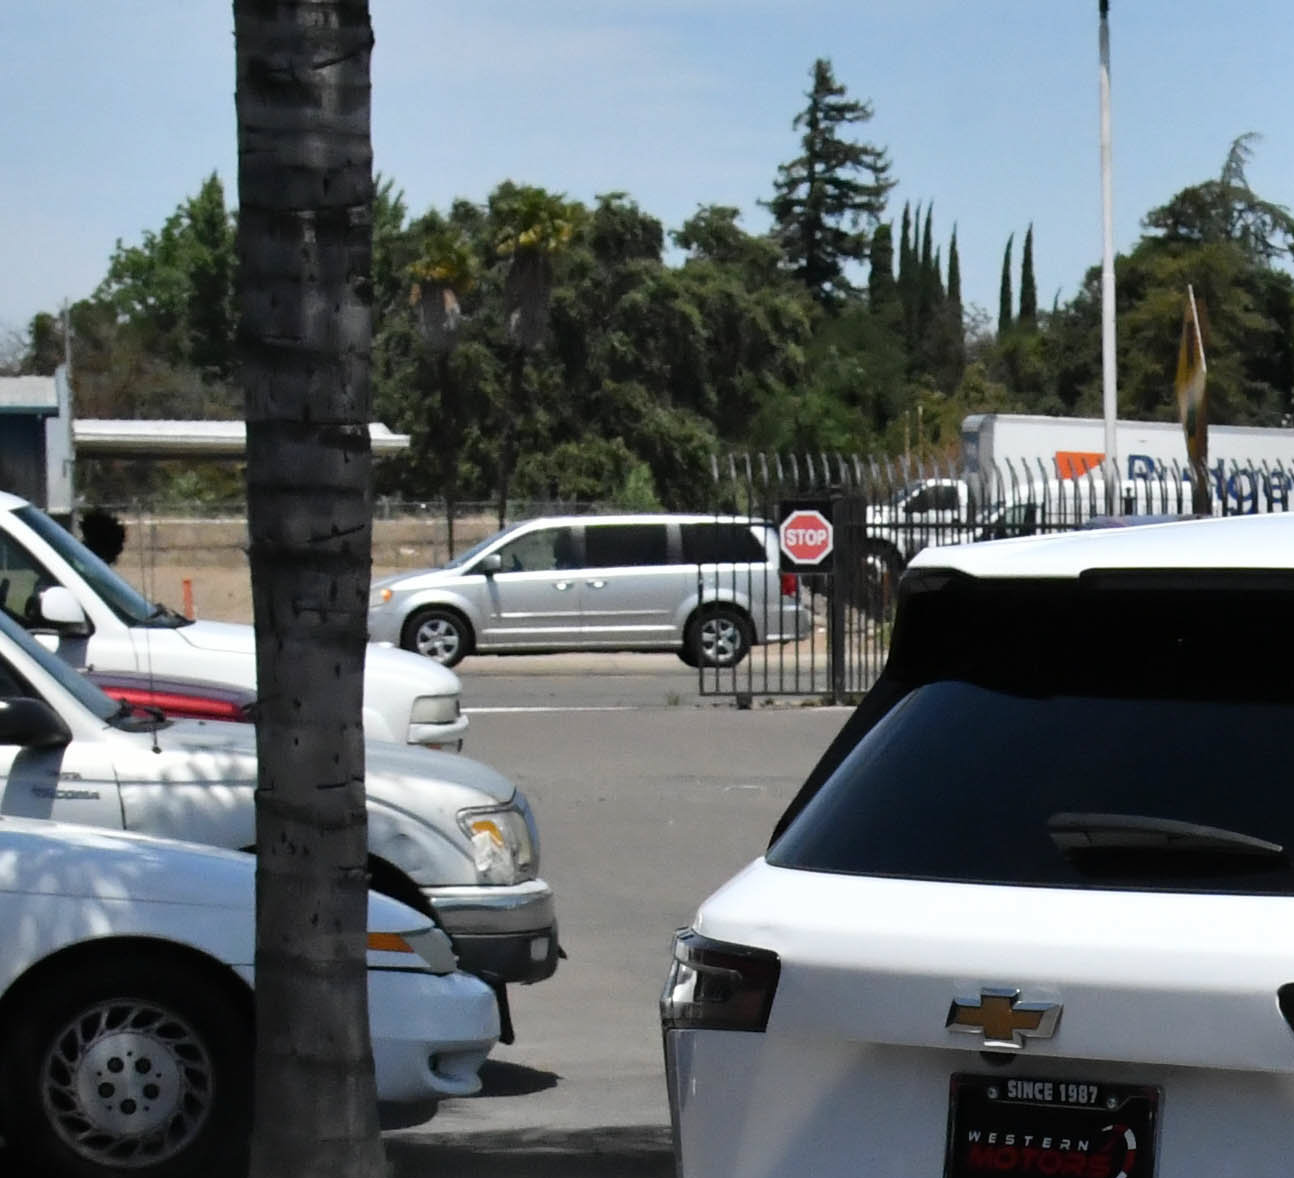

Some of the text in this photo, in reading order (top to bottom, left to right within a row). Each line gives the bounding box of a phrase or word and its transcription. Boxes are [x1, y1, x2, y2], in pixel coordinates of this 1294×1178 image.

[786, 528, 827, 547] STOP
[1007, 1080, 1098, 1103] SINCE 1987
[968, 1130, 1089, 1151] WESTERN
[970, 1146, 1112, 1178] MOTORS
